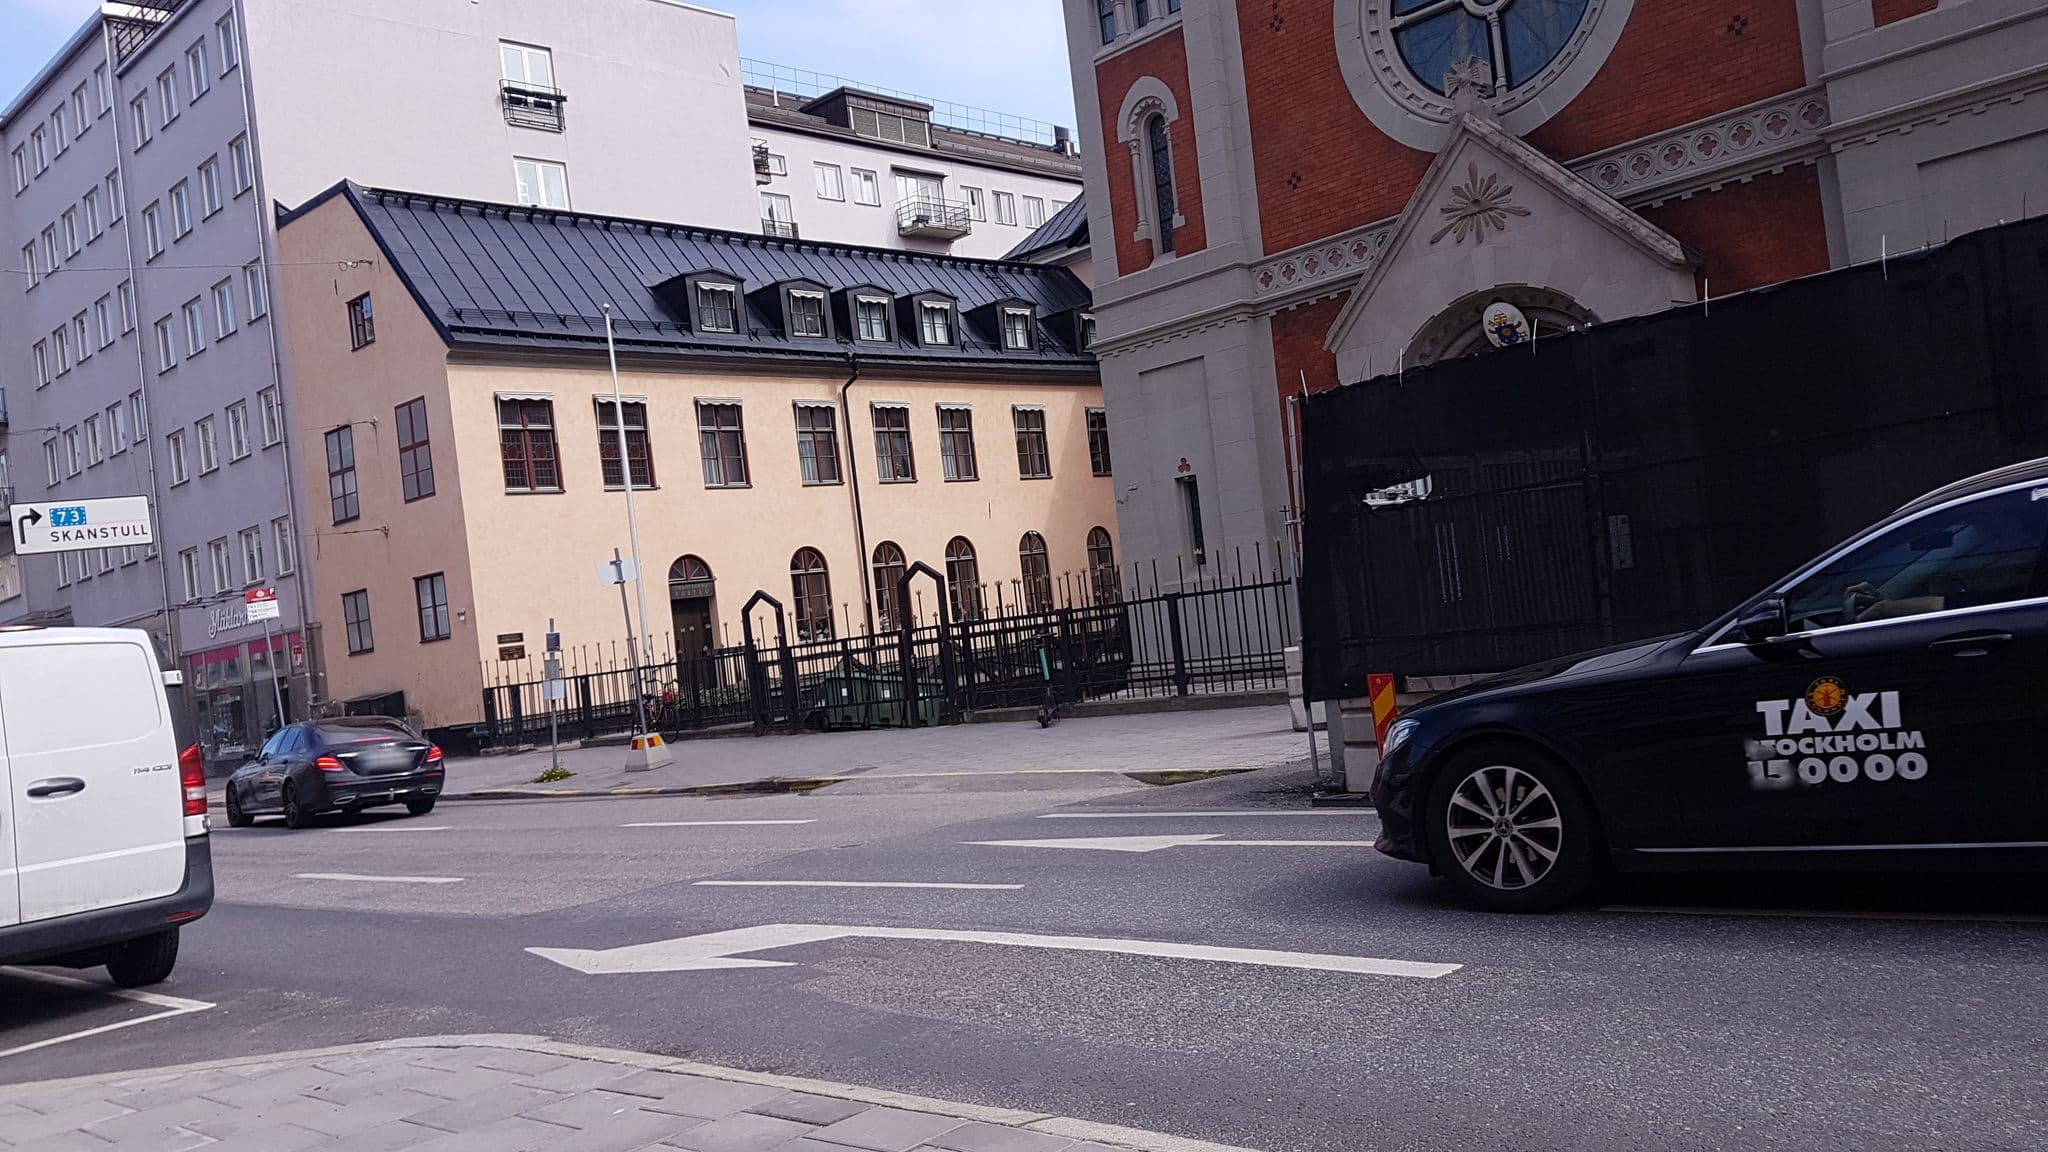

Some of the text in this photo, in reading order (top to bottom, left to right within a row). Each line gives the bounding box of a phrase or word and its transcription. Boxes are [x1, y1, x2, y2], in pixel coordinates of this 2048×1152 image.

[57, 510, 80, 523] 73
[50, 524, 148, 542] SKANSTULL
[1756, 690, 1902, 736] TAXI
[1745, 731, 1926, 758] TOCKHOLM
